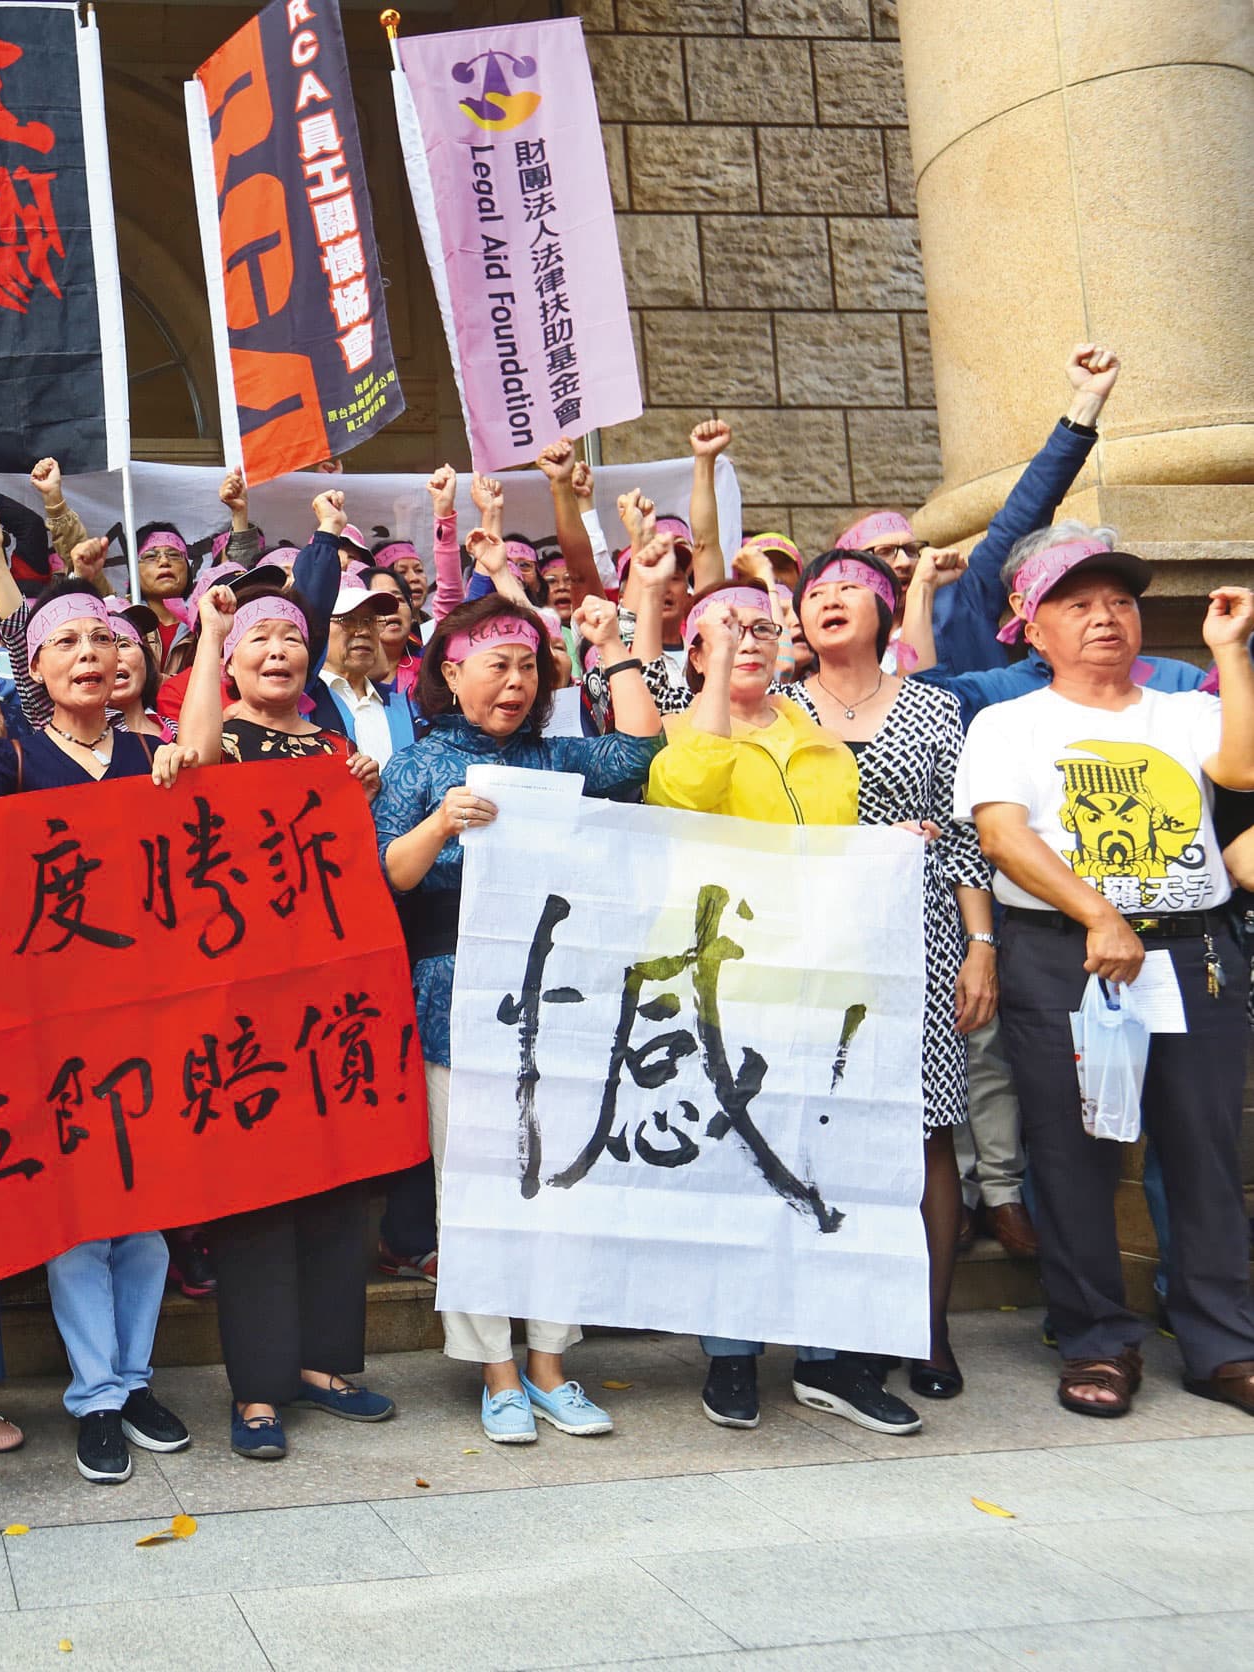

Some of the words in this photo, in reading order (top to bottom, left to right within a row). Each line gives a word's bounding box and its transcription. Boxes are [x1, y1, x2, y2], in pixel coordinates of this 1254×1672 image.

[468, 144, 505, 222] Legal
[480, 234, 512, 280] Aid
[515, 137, 583, 430] 財團法人法律扶助基金會
[488, 291, 535, 448] Foundation
[1082, 873, 1213, 909] 羅天子
